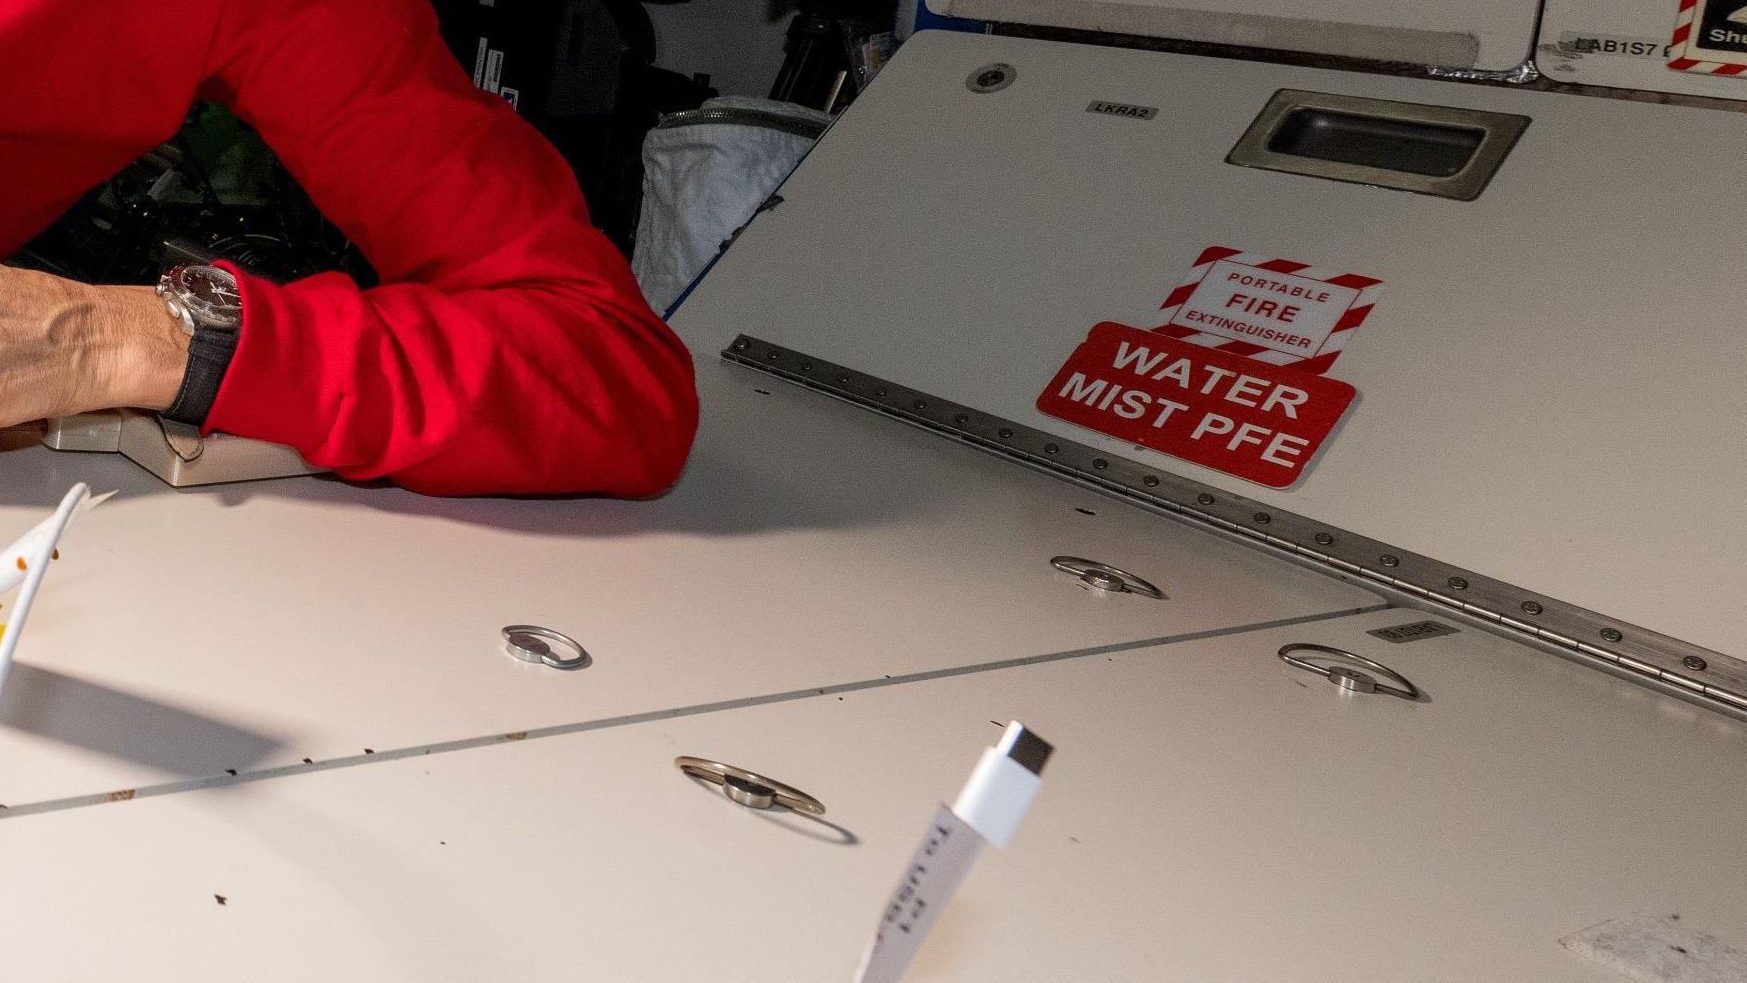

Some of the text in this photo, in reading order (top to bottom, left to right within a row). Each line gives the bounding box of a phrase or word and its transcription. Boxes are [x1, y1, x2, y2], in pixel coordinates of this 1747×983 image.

[1094, 103, 1150, 119] LKRA2
[1226, 271, 1331, 303] PORTABLE
[1225, 293, 1301, 323] FIRE
[1184, 310, 1313, 351] EXTINGUISHER
[1112, 341, 1310, 420] WATER
[1057, 371, 1311, 469] MIST PFE
